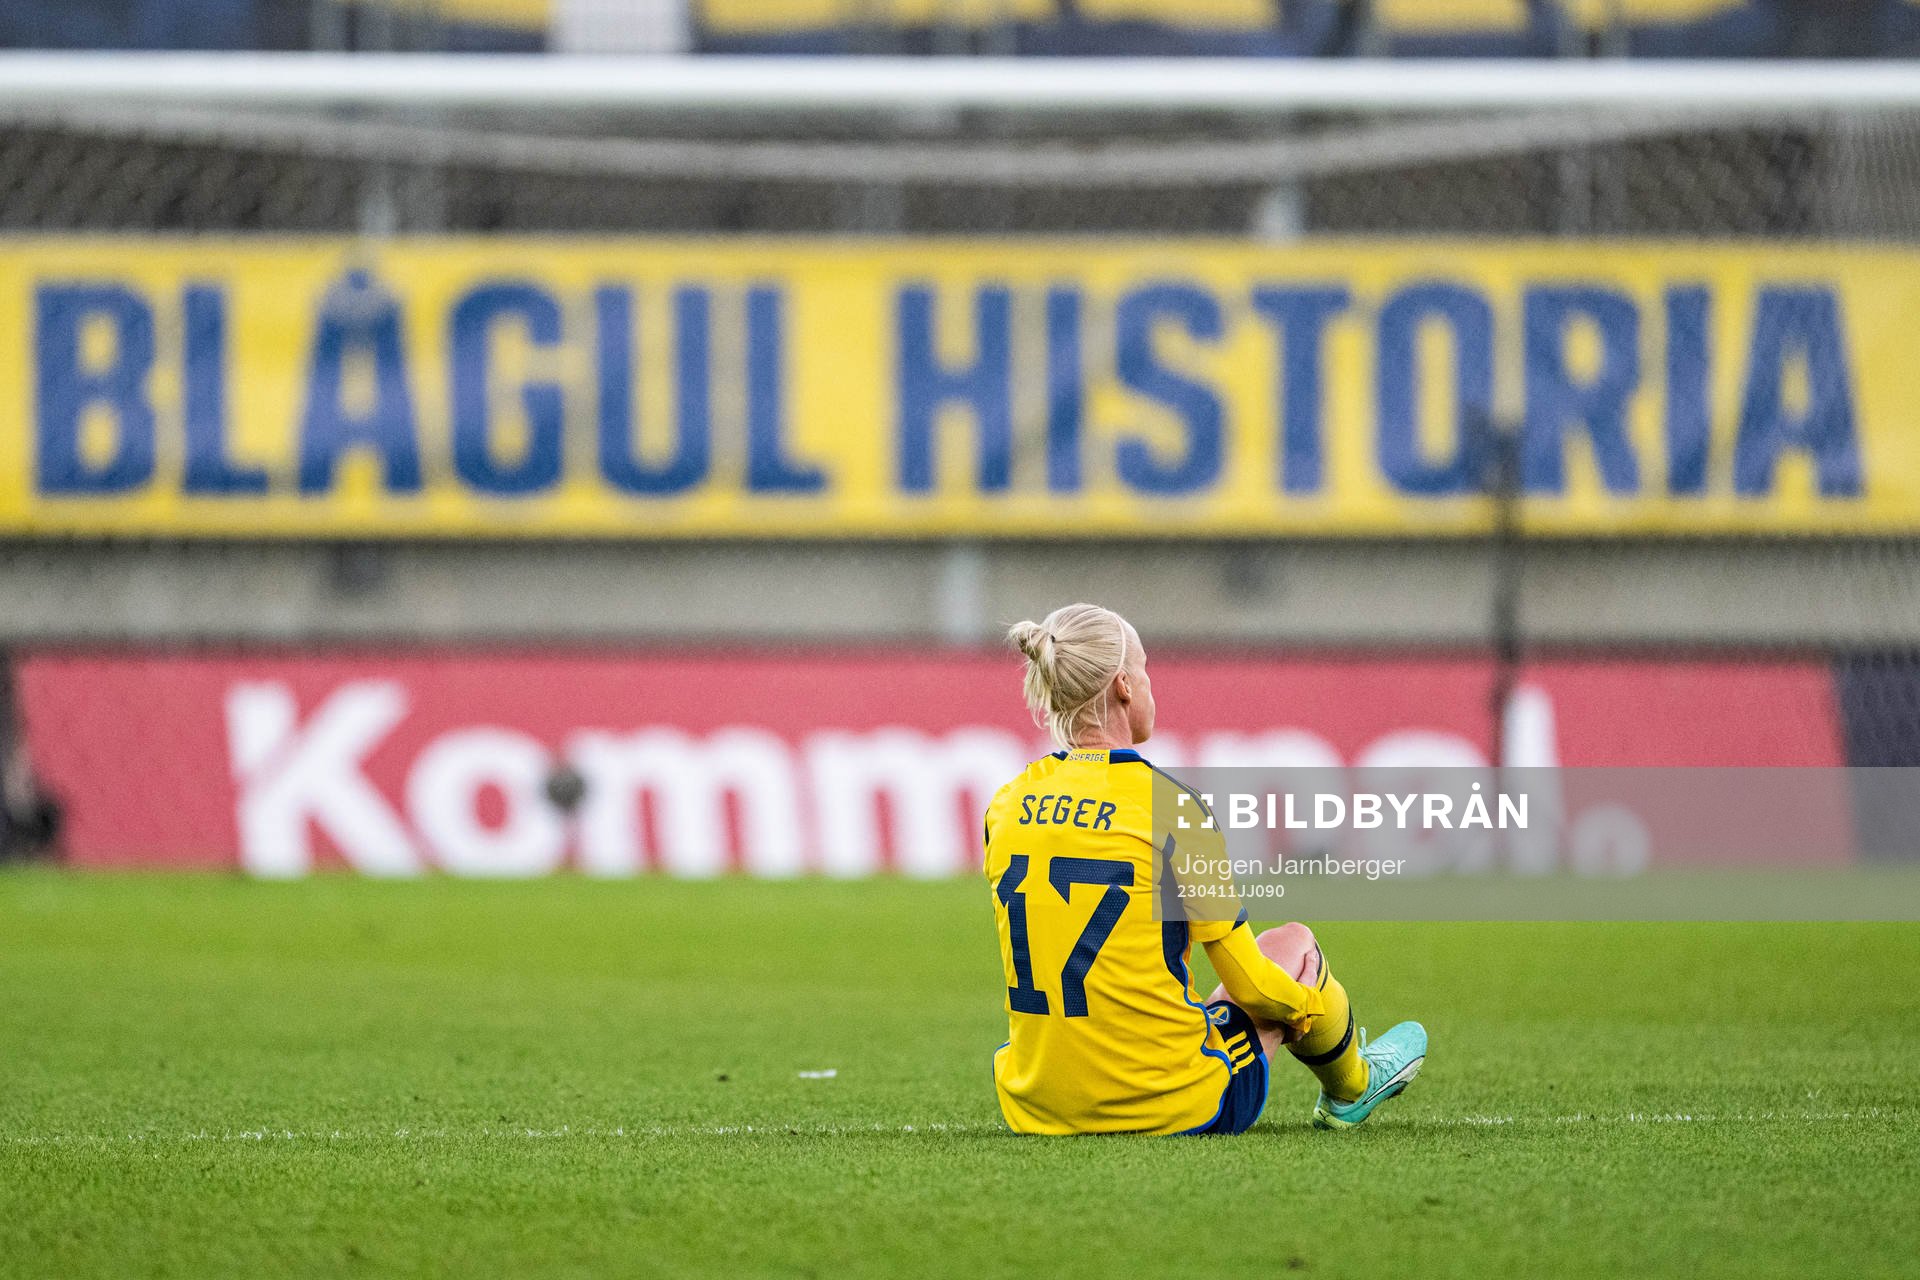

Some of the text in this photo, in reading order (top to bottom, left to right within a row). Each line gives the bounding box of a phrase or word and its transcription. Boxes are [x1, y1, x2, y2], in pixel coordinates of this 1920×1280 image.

[34, 268, 1867, 498] BLÅGUL HISTORIA
[224, 679, 1652, 880] Kommnal.
[1019, 794, 1117, 831] SEGER
[997, 854, 1135, 1017] 17
